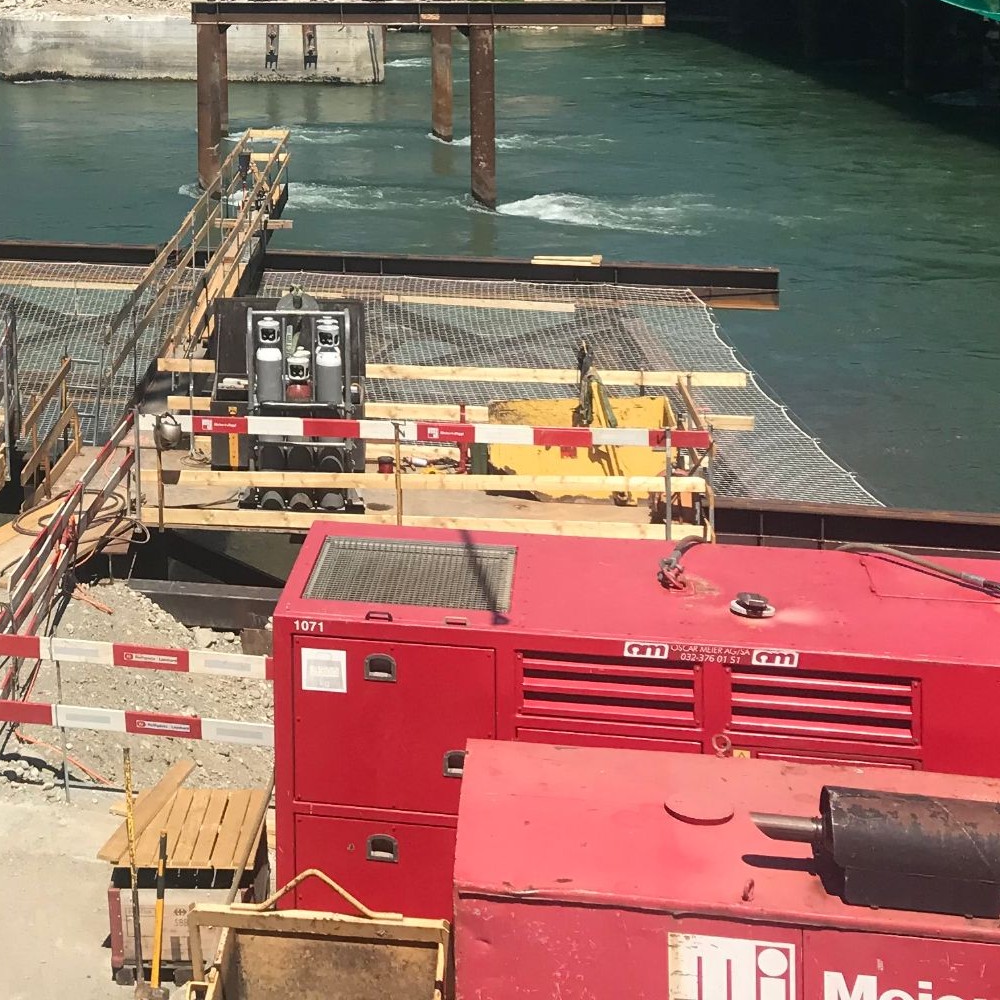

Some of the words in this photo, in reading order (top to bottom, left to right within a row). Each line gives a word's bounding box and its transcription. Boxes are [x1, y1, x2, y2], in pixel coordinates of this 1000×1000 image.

[293, 619, 324, 632] 1071
[671, 644, 699, 653] OSCAR
[700, 646, 723, 654] MEIER
[680, 652, 715, 662] 032-376
[716, 655, 727, 663] 01
